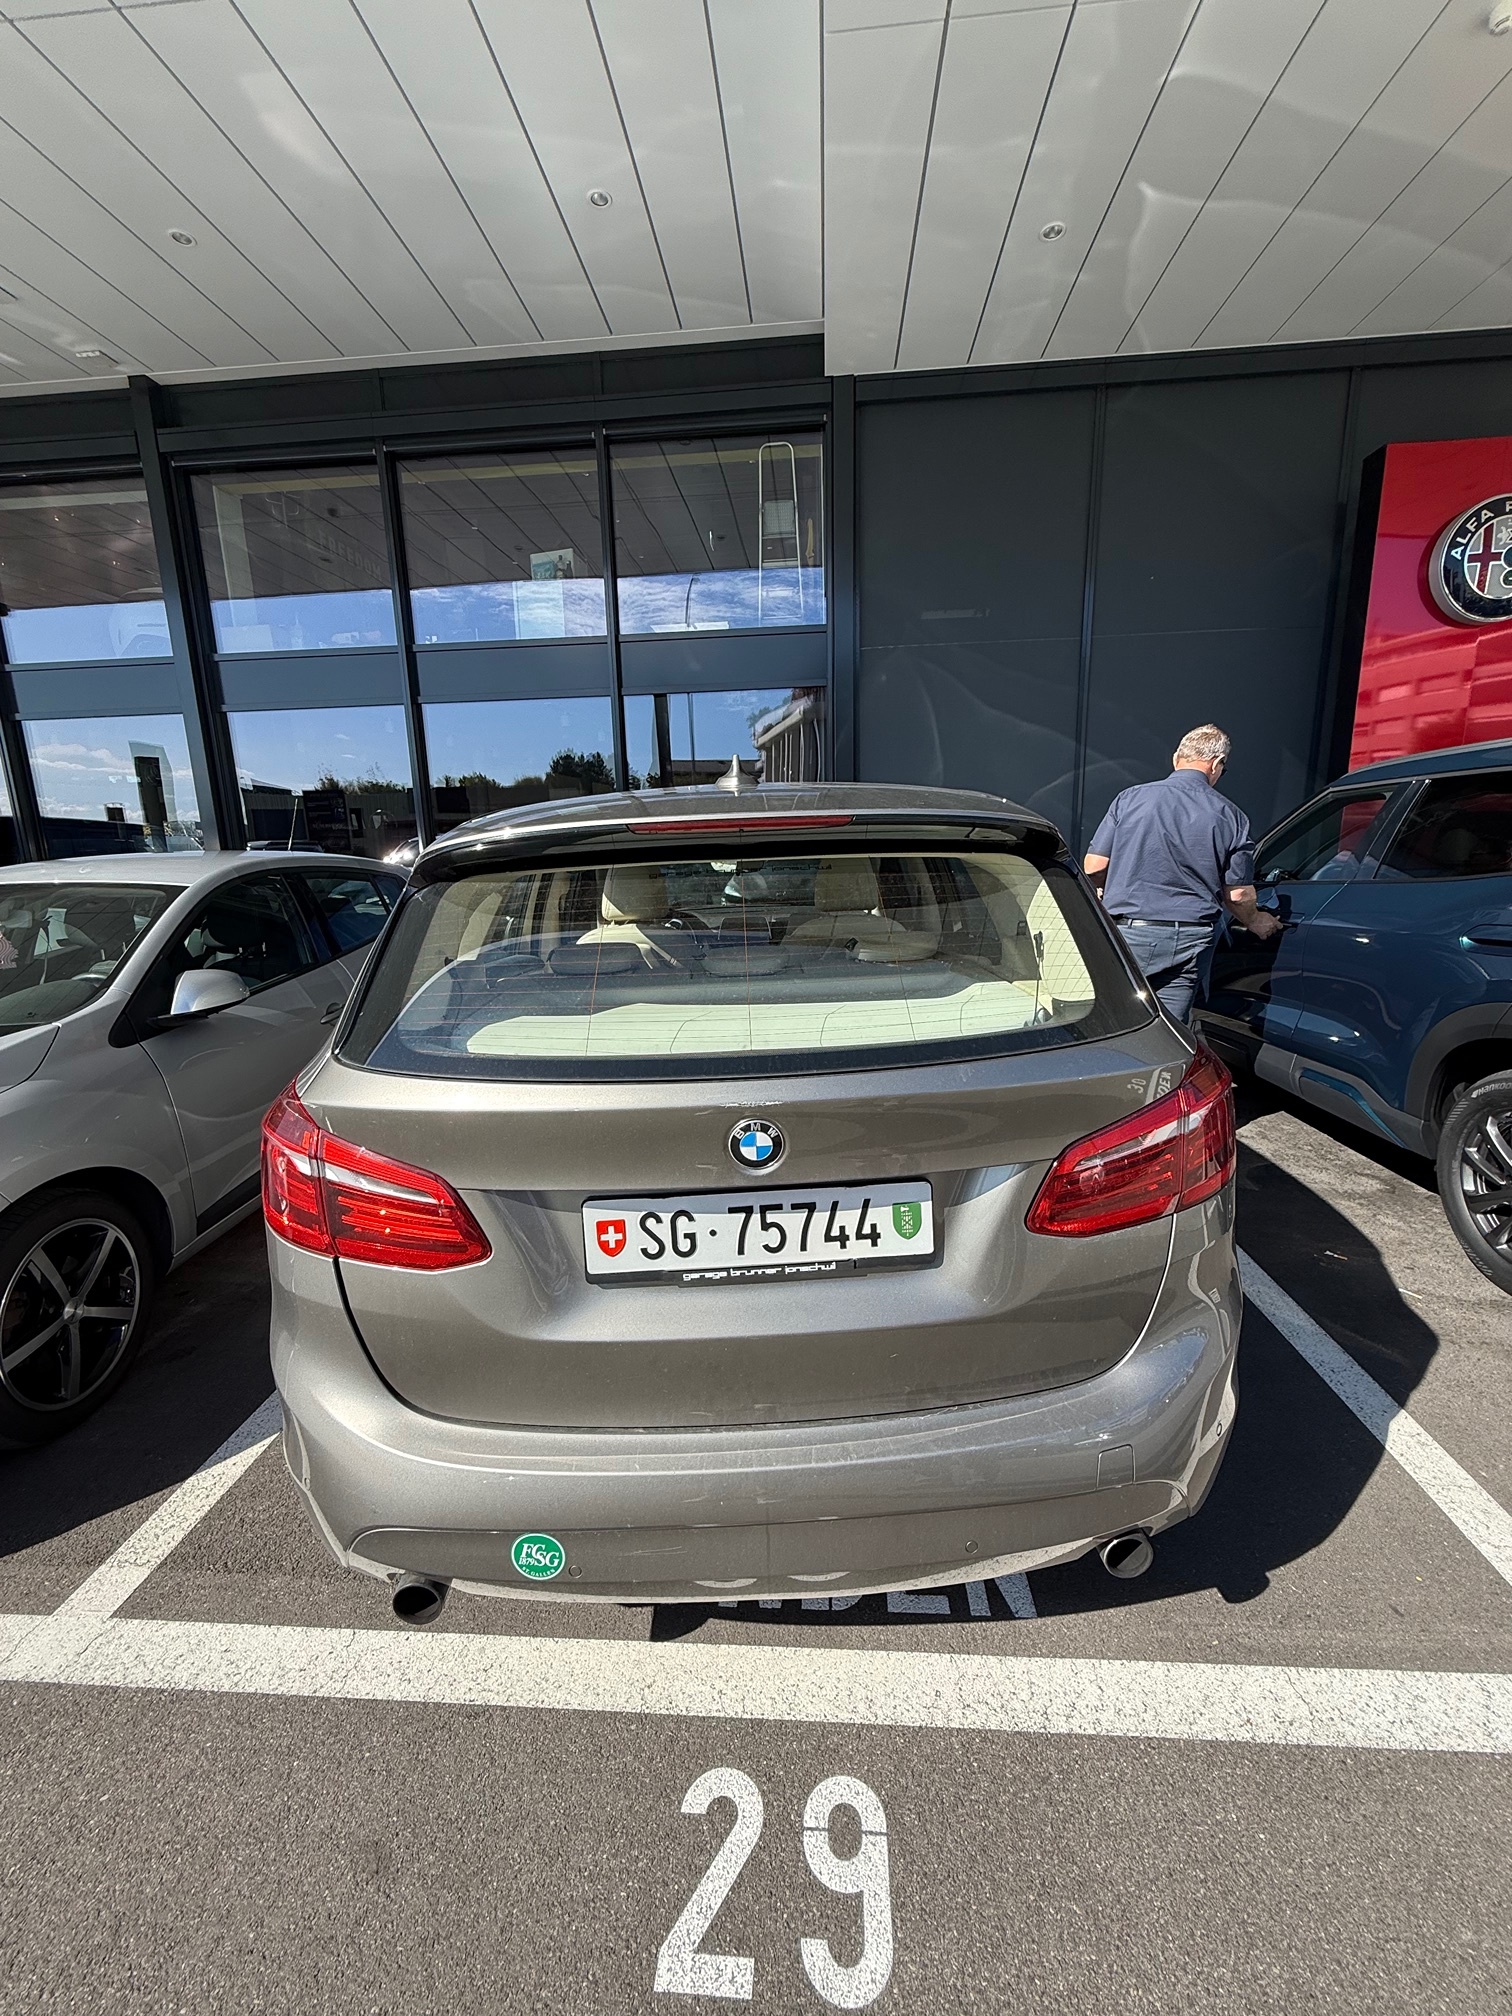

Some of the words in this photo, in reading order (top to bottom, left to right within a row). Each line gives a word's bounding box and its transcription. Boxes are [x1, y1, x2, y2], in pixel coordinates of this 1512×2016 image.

[1451, 509, 1495, 560] ALFA
[733, 1122, 779, 1140] BMW
[683, 1271, 728, 1281] garage
[730, 1268, 782, 1277] brunner
[785, 1261, 836, 1275] jonschwil
[530, 1568, 556, 1577] GALLEN
[653, 1766, 894, 2009] 29
